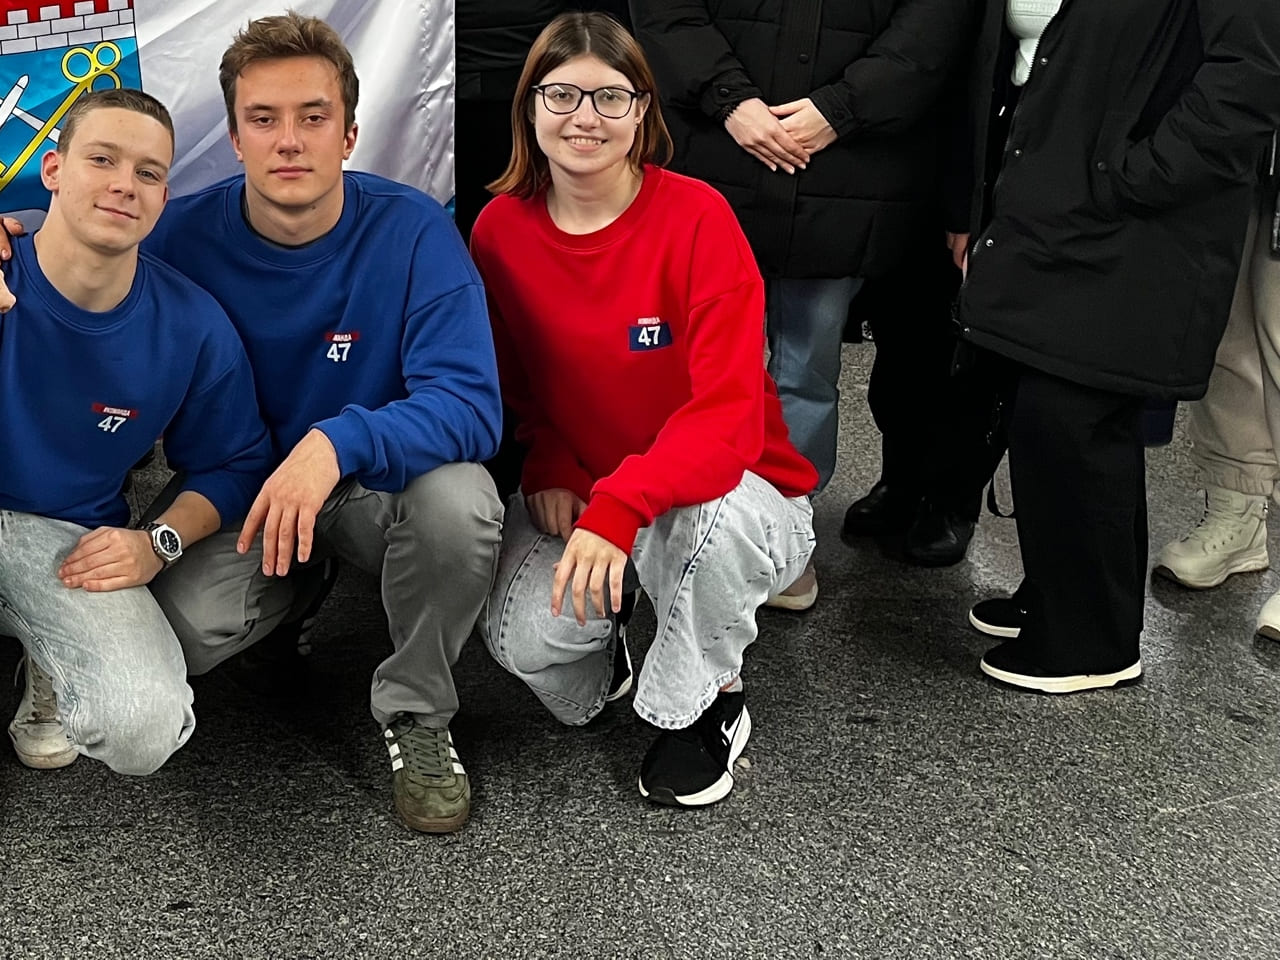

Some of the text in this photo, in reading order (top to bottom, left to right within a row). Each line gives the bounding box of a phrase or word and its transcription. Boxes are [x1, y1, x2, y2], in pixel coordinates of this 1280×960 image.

[637, 325, 661, 346] 47
[326, 342, 352, 362] 47
[97, 415, 127, 433] 47
